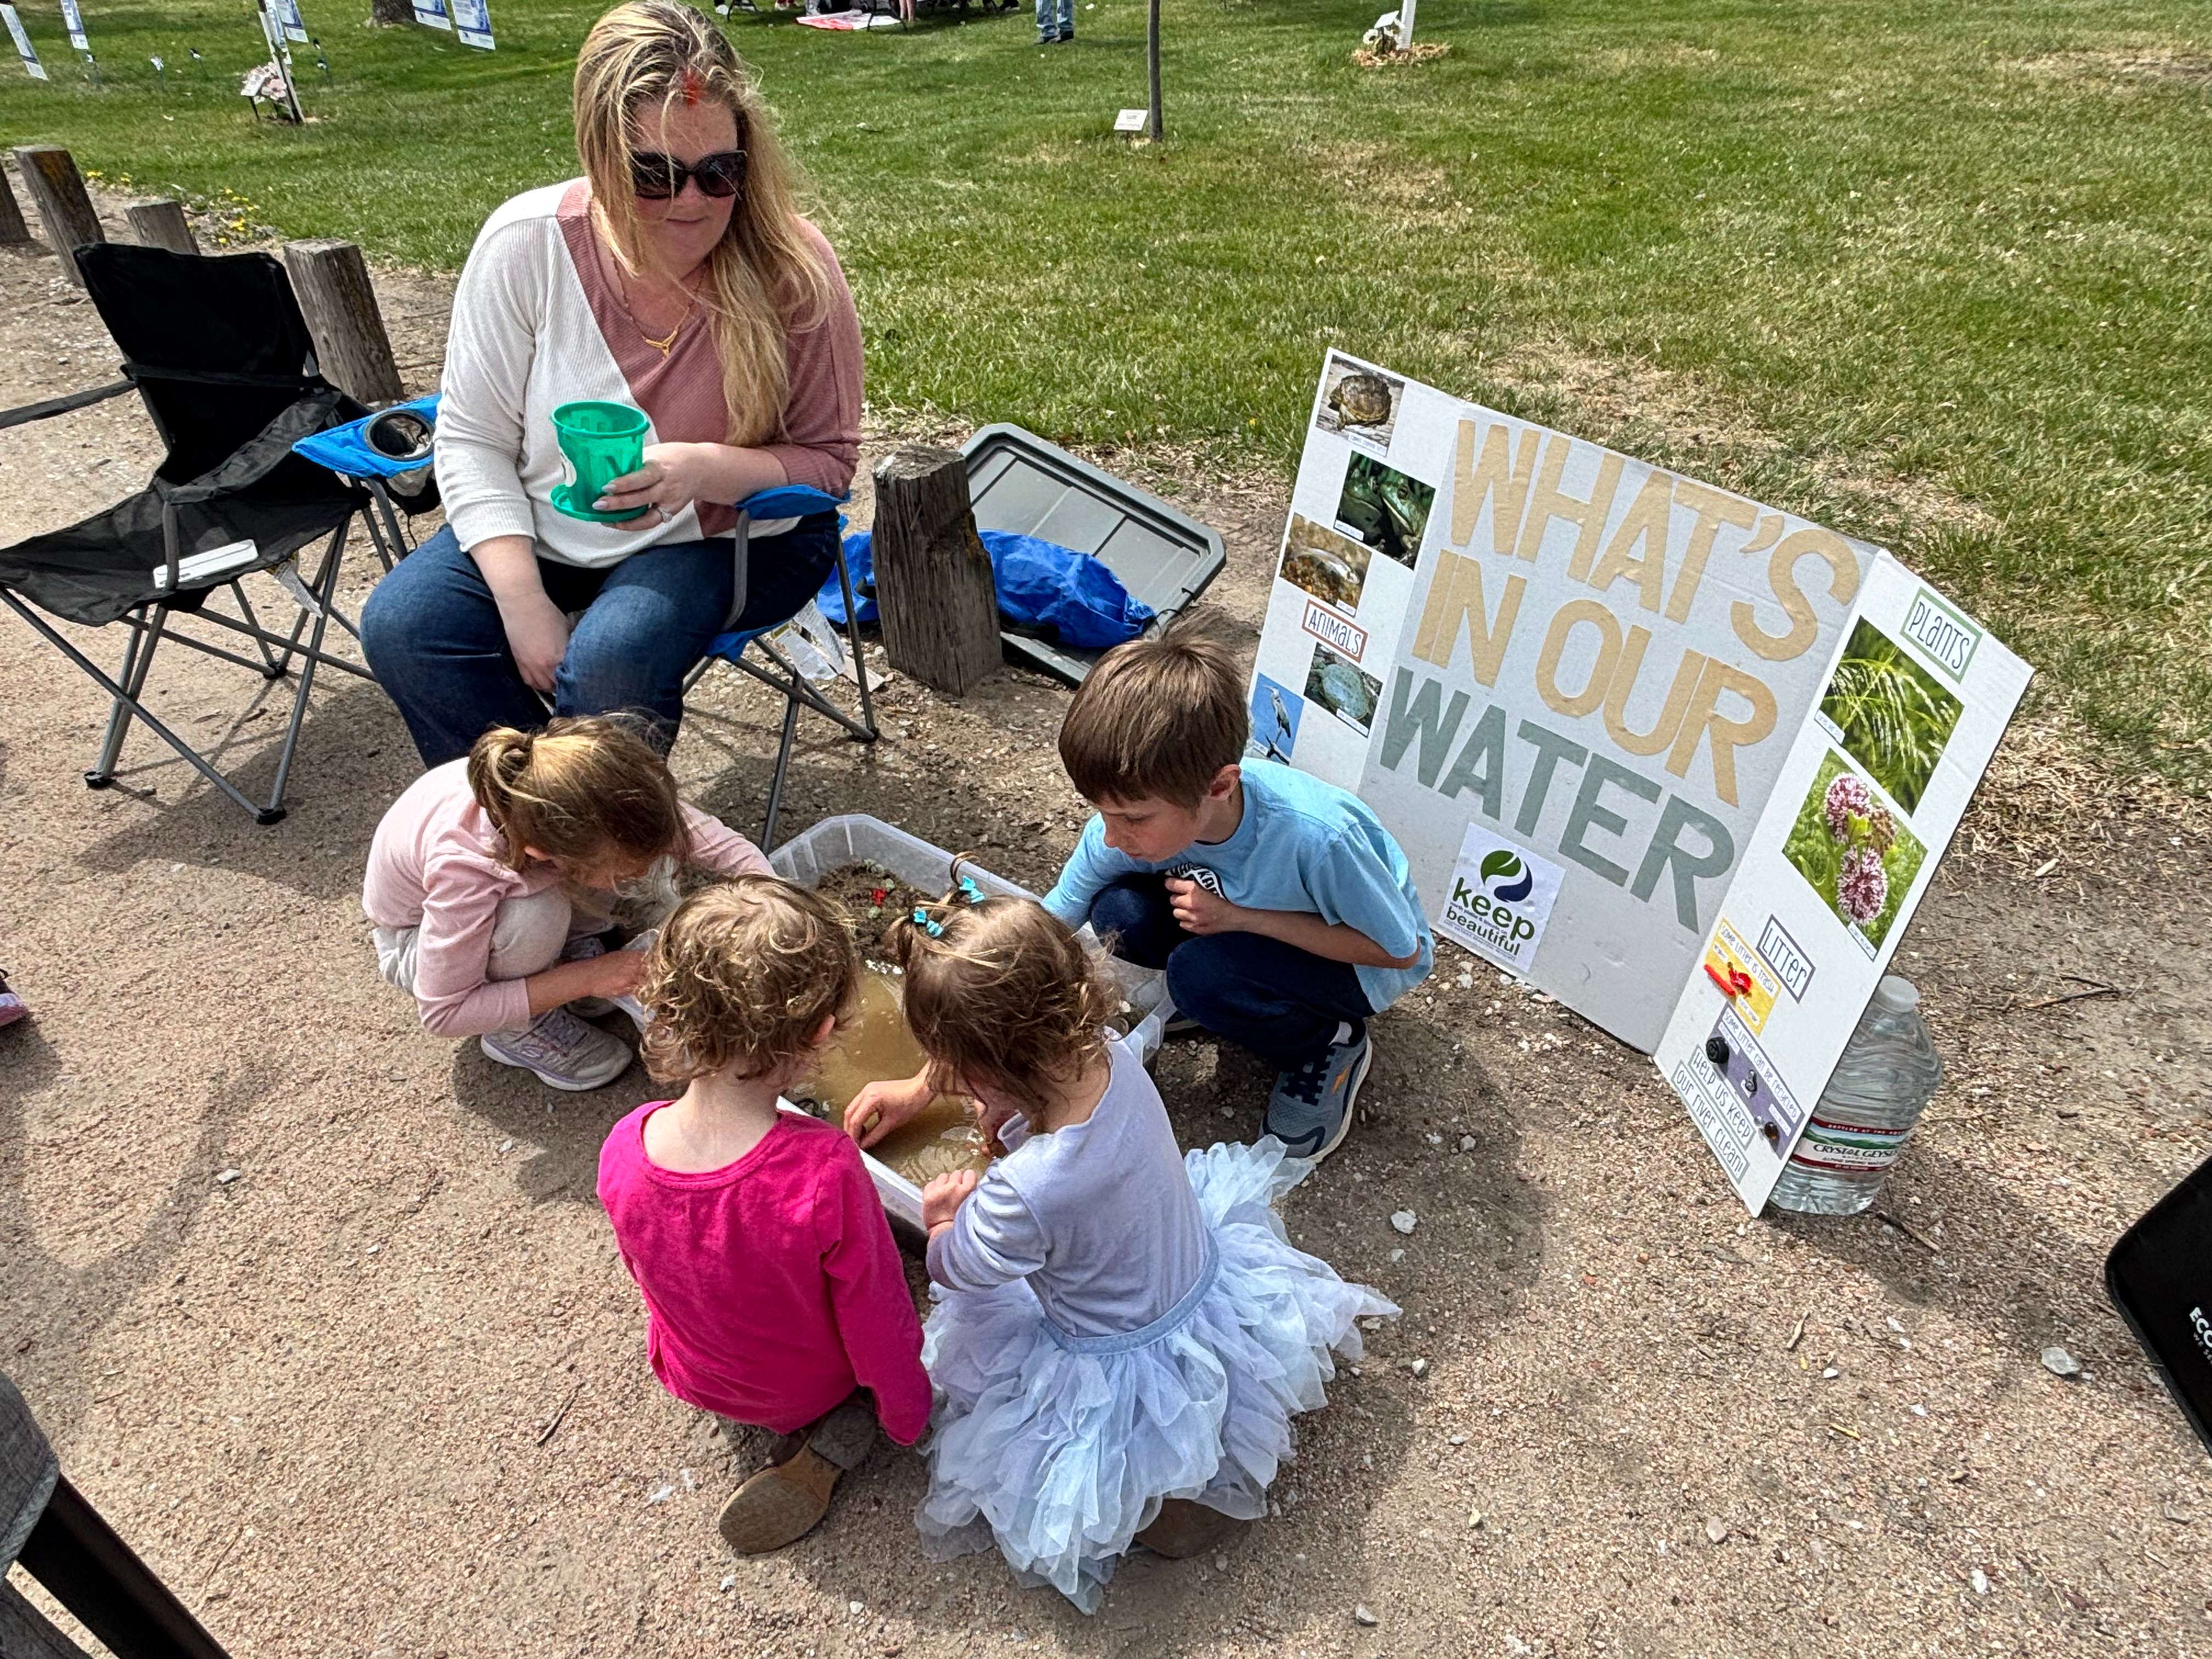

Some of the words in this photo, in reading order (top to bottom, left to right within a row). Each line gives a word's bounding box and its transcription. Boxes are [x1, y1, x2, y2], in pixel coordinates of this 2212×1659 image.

[1451, 420, 1860, 662] WHAT'S
[1412, 549, 1527, 688] IN
[1536, 599, 1777, 808] OUR
[1379, 666, 1735, 930] WATER
[1446, 906, 1521, 956] beautiful
[1452, 877, 1535, 941] keep
[1813, 1144, 1860, 1156] CRYSTAL
